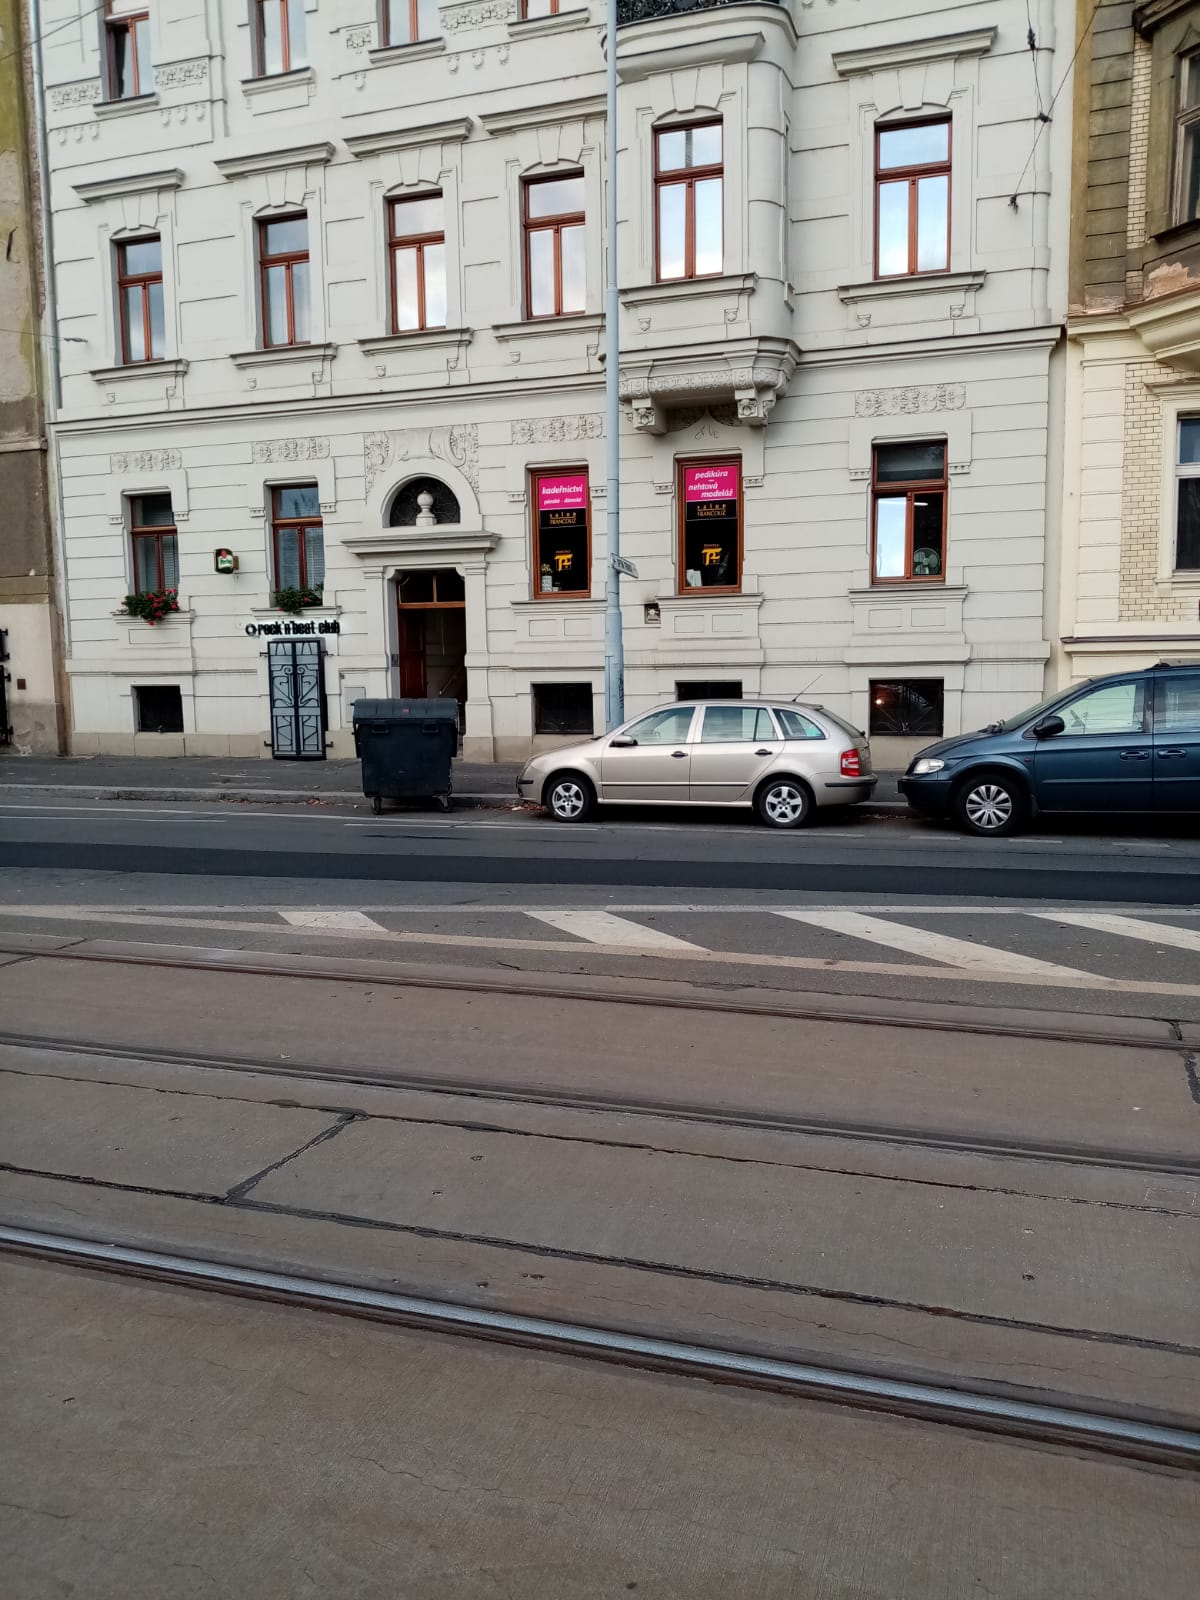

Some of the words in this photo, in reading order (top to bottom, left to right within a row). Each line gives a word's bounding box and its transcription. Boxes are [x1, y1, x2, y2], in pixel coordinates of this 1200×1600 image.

[695, 470, 728, 480] pedikúra
[542, 484, 582, 494] kadeřnictví
[688, 482, 718, 490] nehtová
[701, 489, 733, 498] modeláž
[318, 620, 340, 634] club
